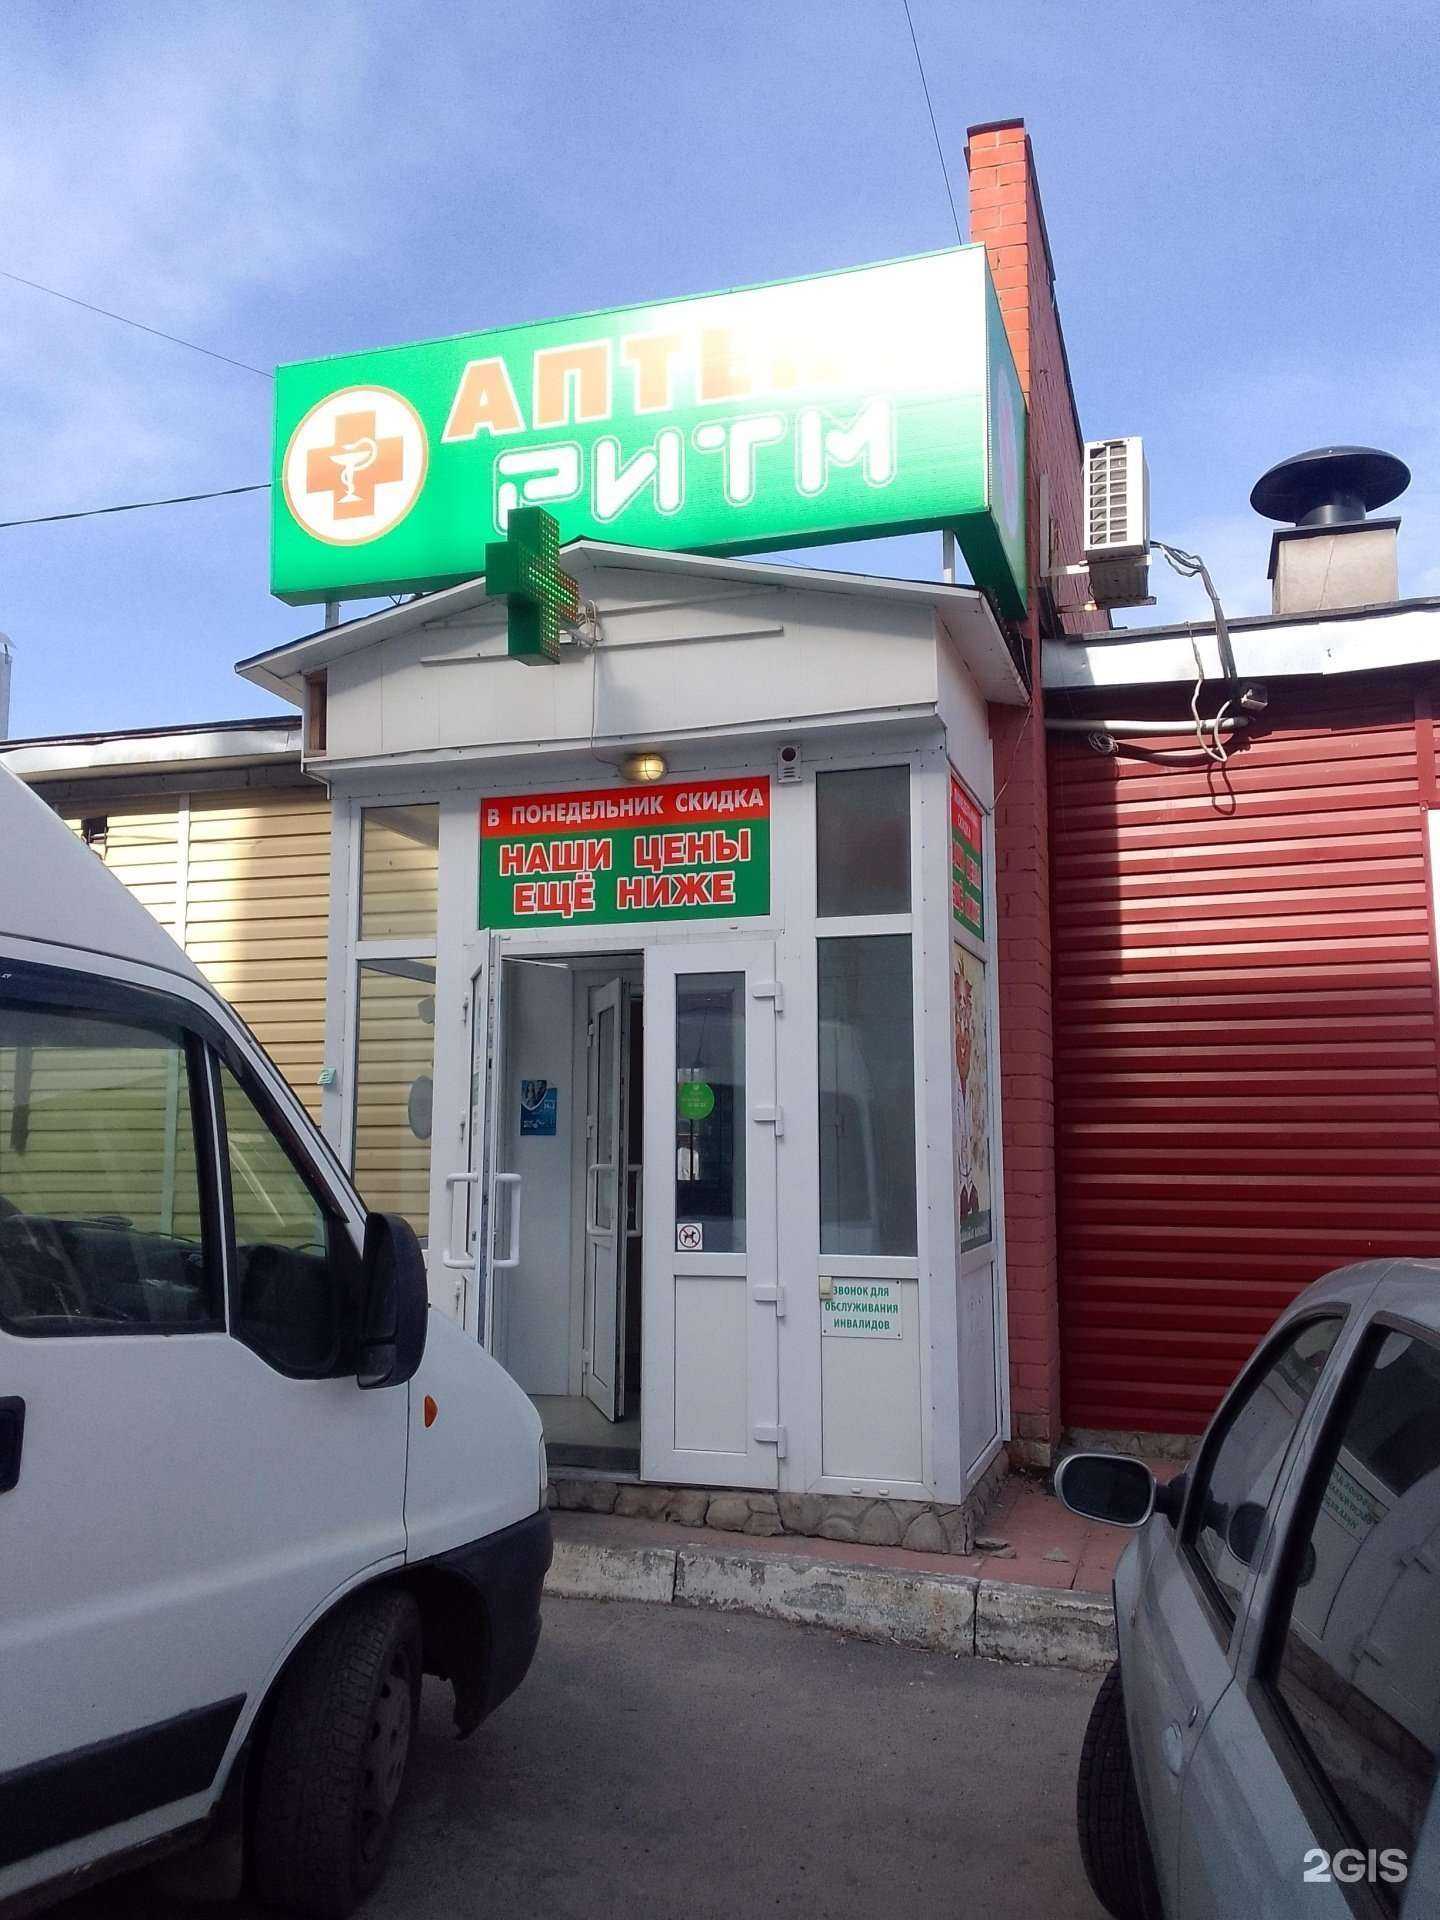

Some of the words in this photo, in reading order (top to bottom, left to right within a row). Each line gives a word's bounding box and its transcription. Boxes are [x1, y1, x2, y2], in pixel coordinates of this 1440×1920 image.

[493, 393, 897, 535] РИТМ
[487, 808, 500, 827] В
[511, 796, 664, 825] ПОНЕДЕЛЬНИК
[675, 788, 764, 813] СКИДКА
[499, 838, 612, 877] НАШИ
[634, 828, 751, 874] ЦЕНЫ
[513, 872, 595, 918] ЕЩЁ
[616, 871, 735, 910] НИЖЕ
[824, 1302, 899, 1314] ОБСЛУЖИВАНИЯ
[832, 1286, 869, 1297] ЗВОНОК
[870, 1287, 890, 1298] ДЛЯ
[834, 1319, 890, 1331] ИНВАЛИДОВ
